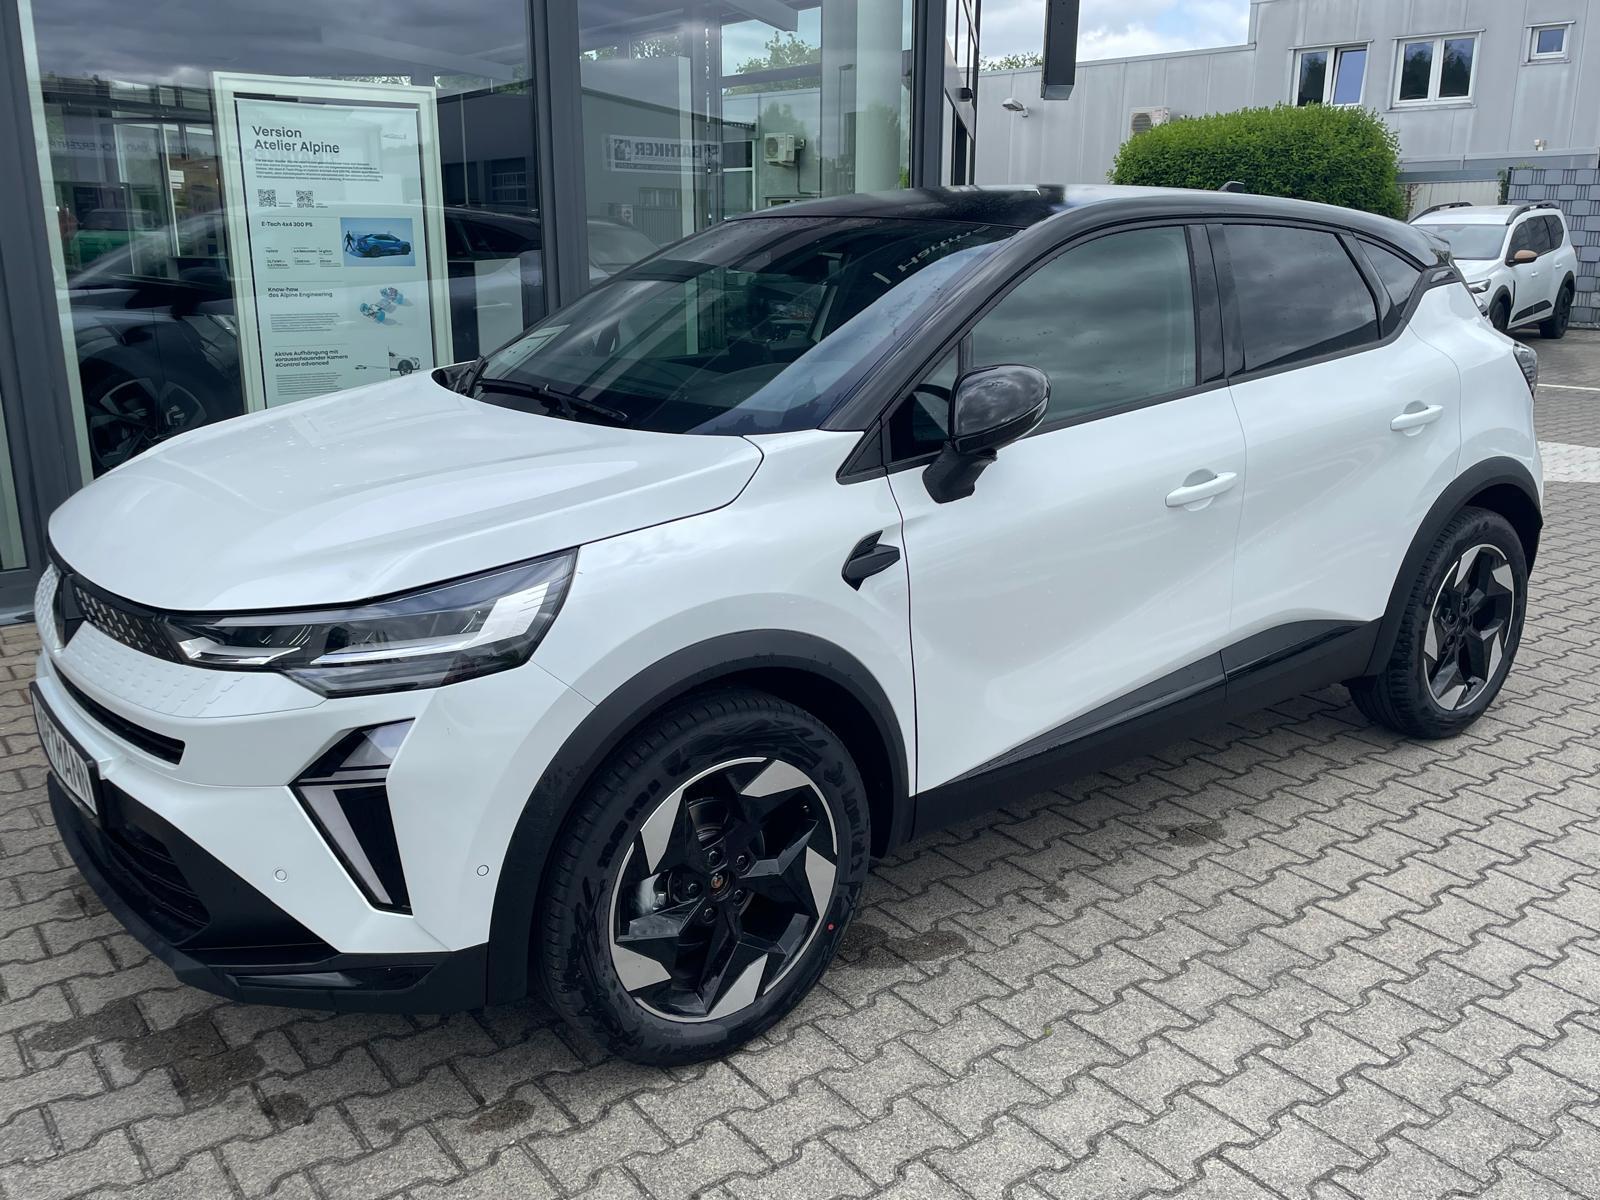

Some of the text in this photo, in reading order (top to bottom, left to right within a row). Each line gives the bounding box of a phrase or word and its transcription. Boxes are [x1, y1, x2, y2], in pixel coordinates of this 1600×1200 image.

[252, 125, 302, 138] Version
[254, 139, 340, 155] Atelier Alpine
